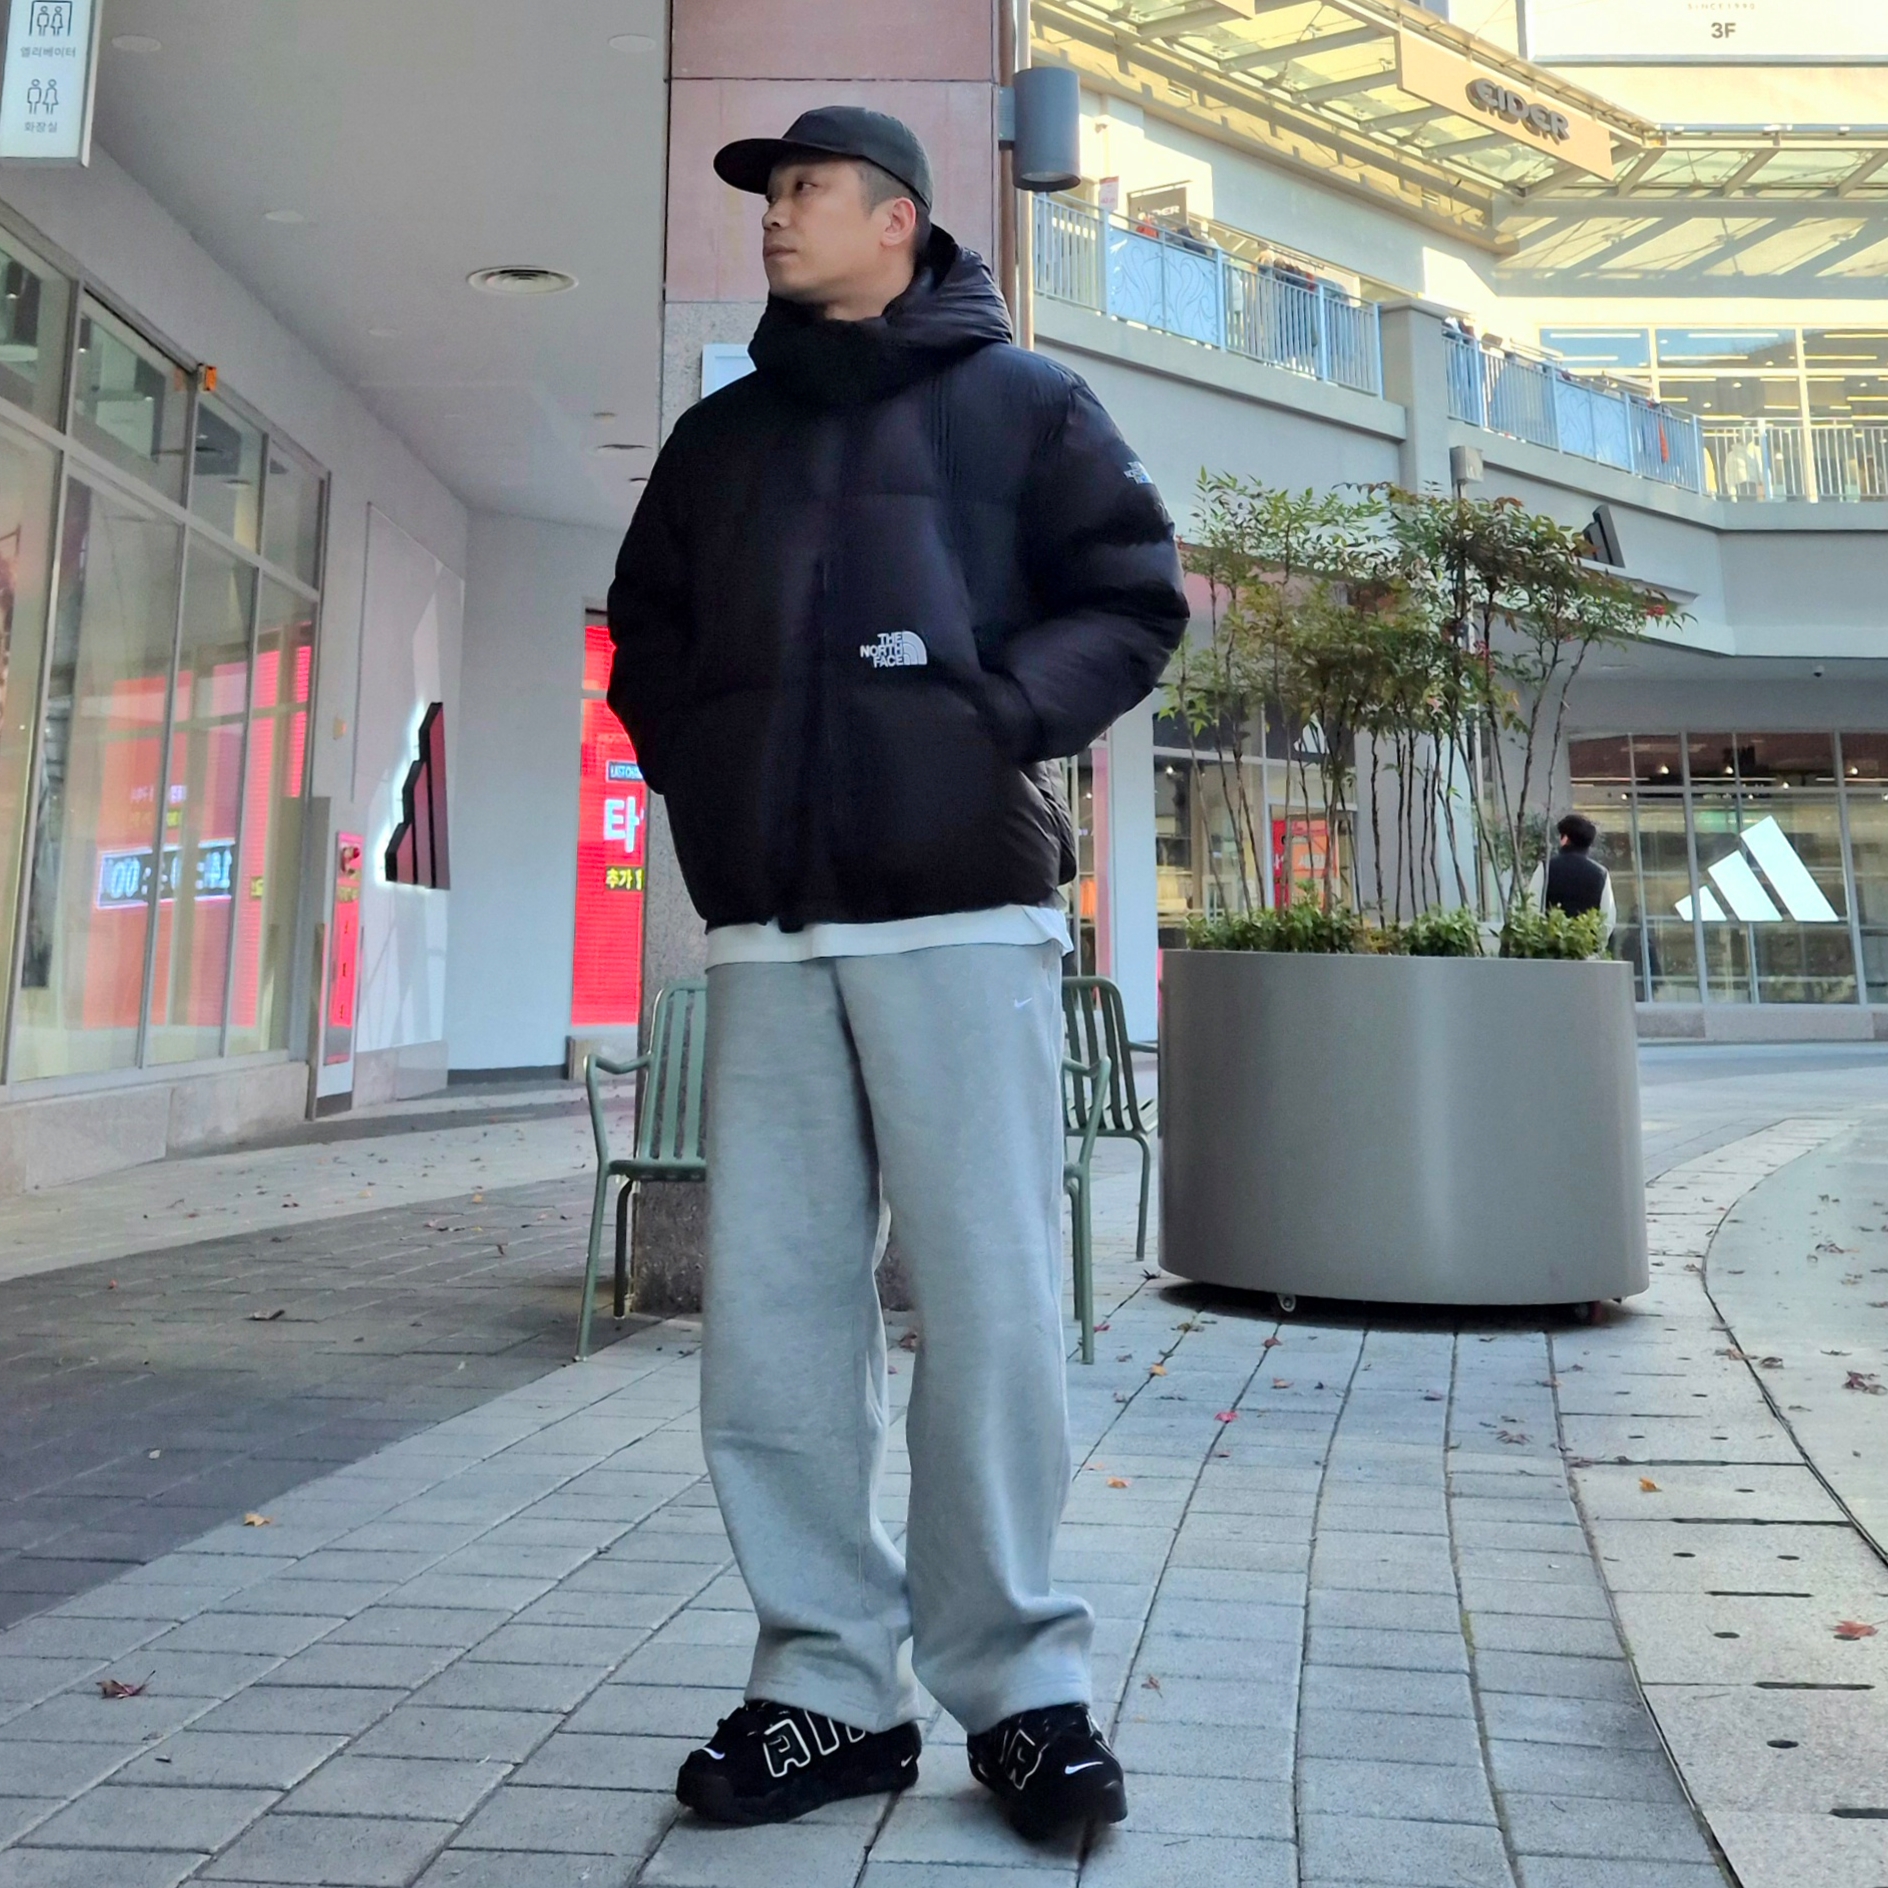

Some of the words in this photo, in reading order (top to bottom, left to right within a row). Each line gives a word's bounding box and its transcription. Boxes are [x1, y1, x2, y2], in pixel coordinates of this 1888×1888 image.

[1710, 22, 1736, 39] 3F
[1468, 78, 1570, 143] EIDER
[24, 122, 58, 133] 화장실
[877, 632, 902, 645] THE
[860, 644, 903, 658] NORTH
[873, 656, 904, 668] FACE
